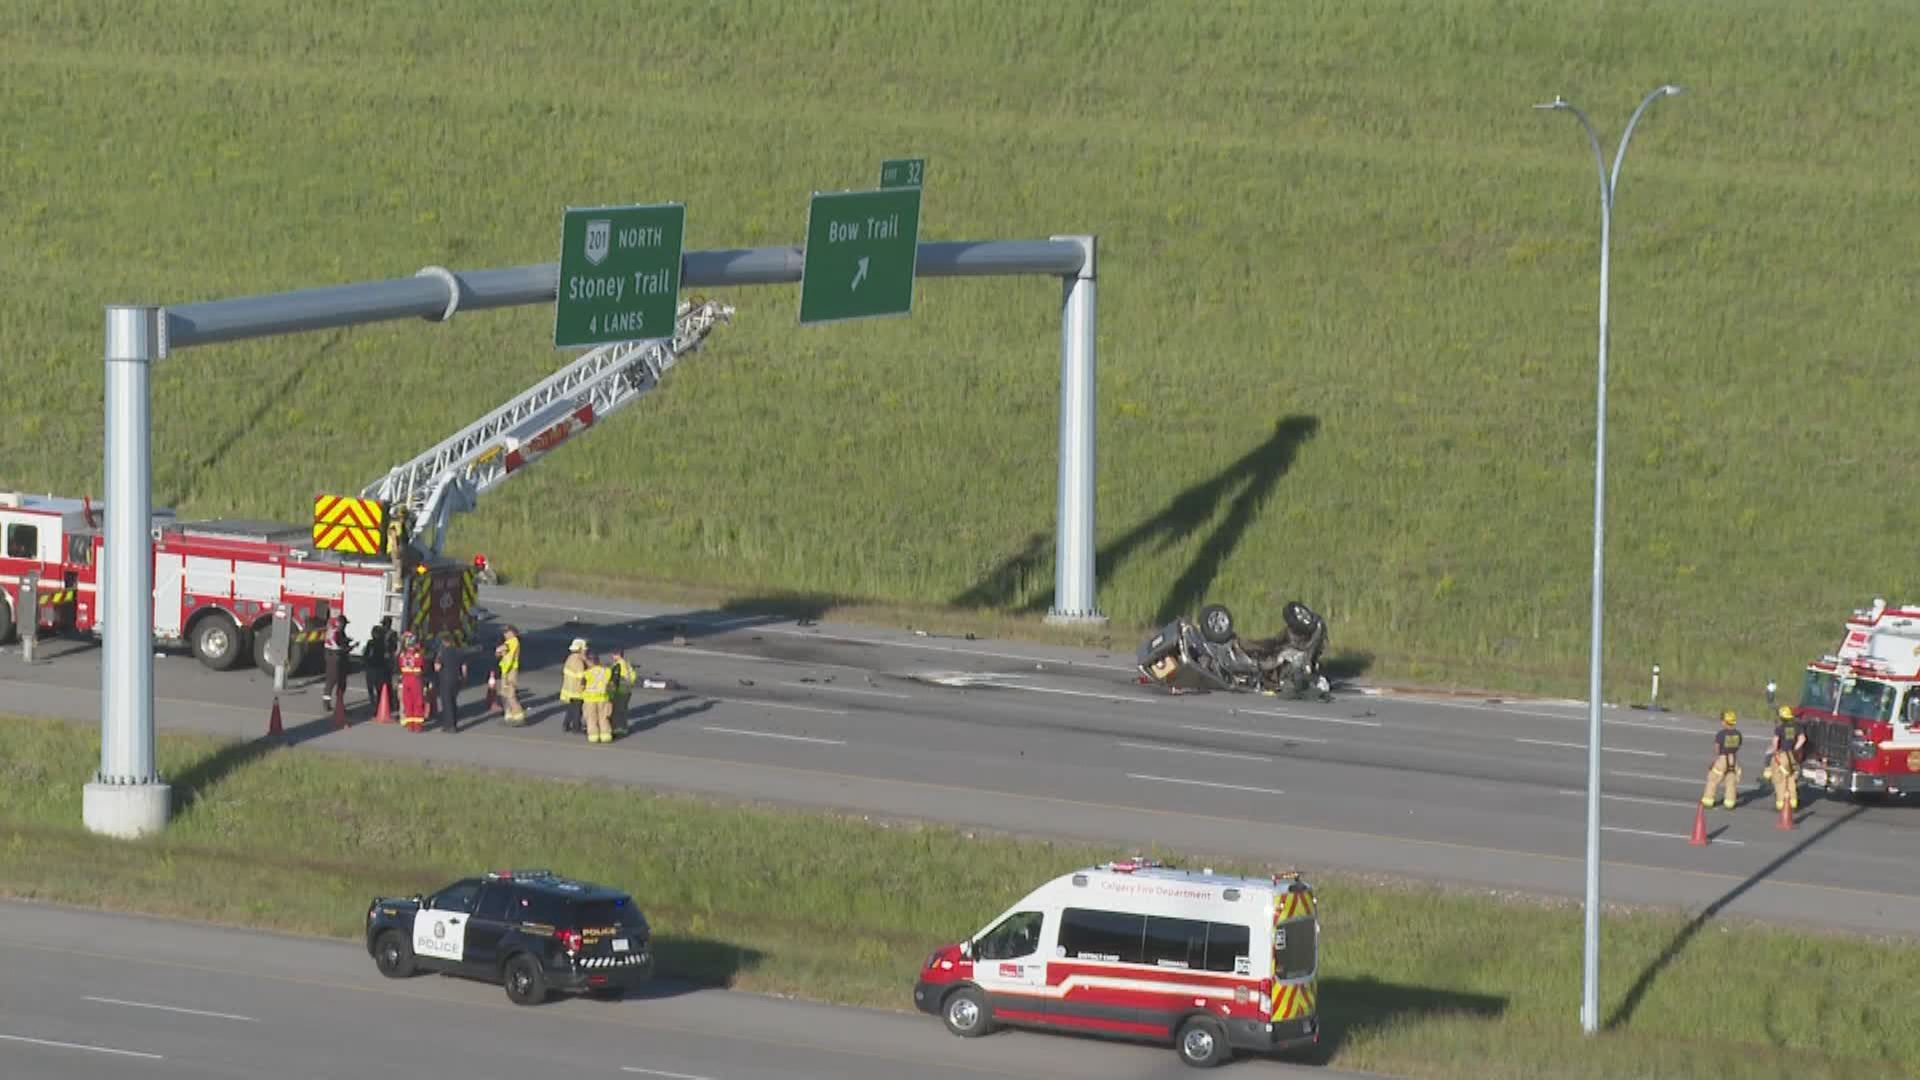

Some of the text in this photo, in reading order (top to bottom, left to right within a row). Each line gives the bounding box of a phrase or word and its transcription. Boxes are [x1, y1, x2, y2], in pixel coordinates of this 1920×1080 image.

[906, 161, 921, 184] 32
[617, 226, 662, 249] NORTH
[829, 213, 899, 243] Bow Trail
[588, 230, 608, 251] 201
[568, 267, 670, 303] Stoney Trail
[588, 310, 644, 335] 4 LANES
[1101, 880, 1211, 900] Calgary Fire Department
[582, 926, 617, 937] POLICE
[417, 936, 460, 954] POLICE
